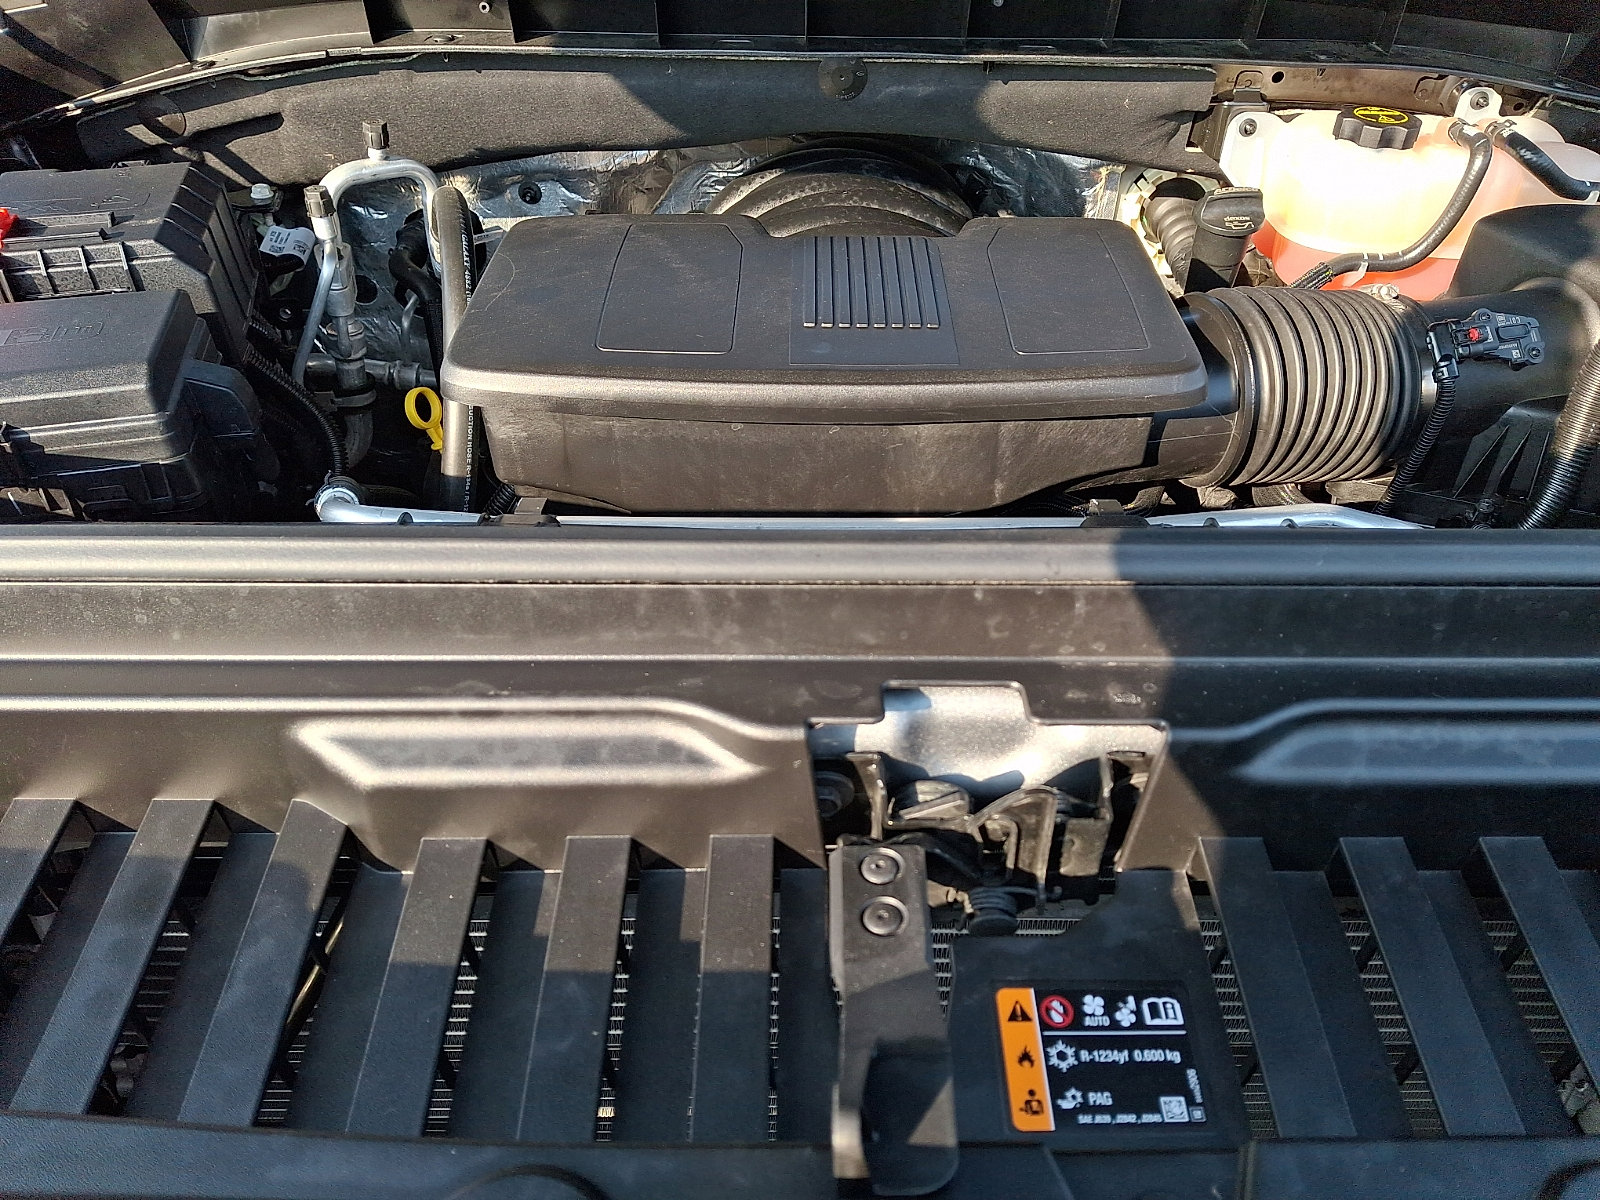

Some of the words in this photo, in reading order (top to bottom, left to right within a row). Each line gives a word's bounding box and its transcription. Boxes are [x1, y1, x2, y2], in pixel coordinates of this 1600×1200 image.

[461, 234, 471, 269] GALAXY
[1084, 1015, 1111, 1027] AUTO
[1079, 1049, 1130, 1064] R-1234yf
[1166, 1049, 1181, 1064] kg
[1088, 1091, 1113, 1106] PAG
